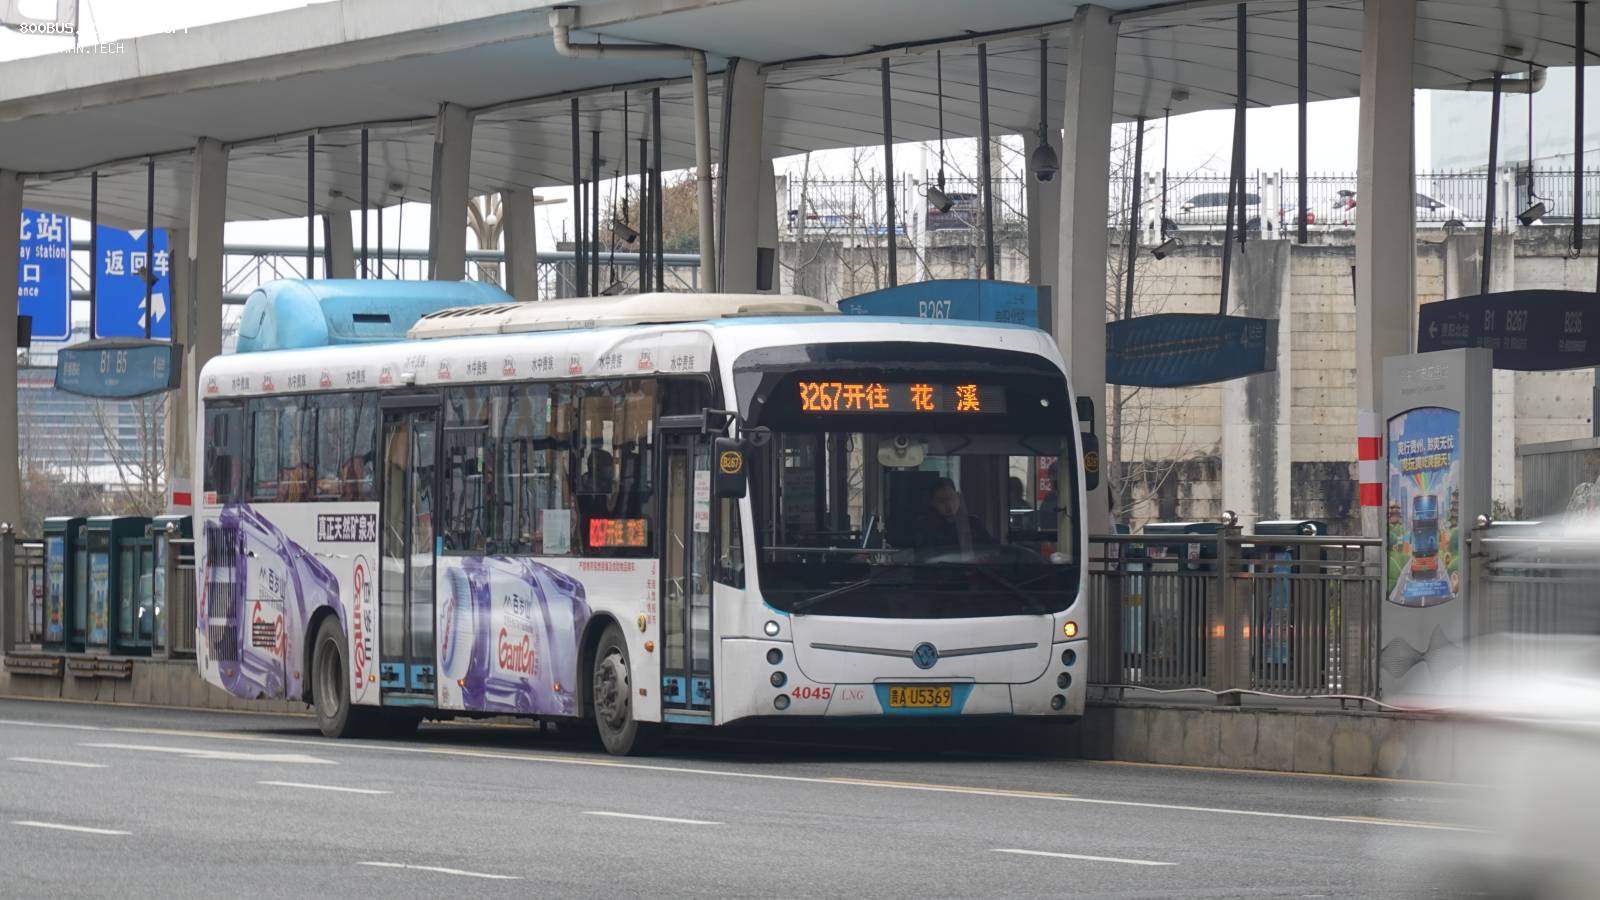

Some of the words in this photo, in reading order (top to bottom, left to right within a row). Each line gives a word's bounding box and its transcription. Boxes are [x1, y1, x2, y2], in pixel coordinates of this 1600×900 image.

[35, 244, 66, 259] station
[919, 300, 952, 319] B267
[670, 353, 695, 371] 水中贵族
[910, 384, 935, 410] 花
[956, 384, 980, 411] 溪
[723, 456, 739, 468] B267
[318, 516, 376, 541] 真正天然矿泉水
[353, 563, 364, 689] Ganten
[498, 626, 535, 677] Ganten
[792, 687, 830, 700] 4045
[842, 690, 864, 700] LNG
